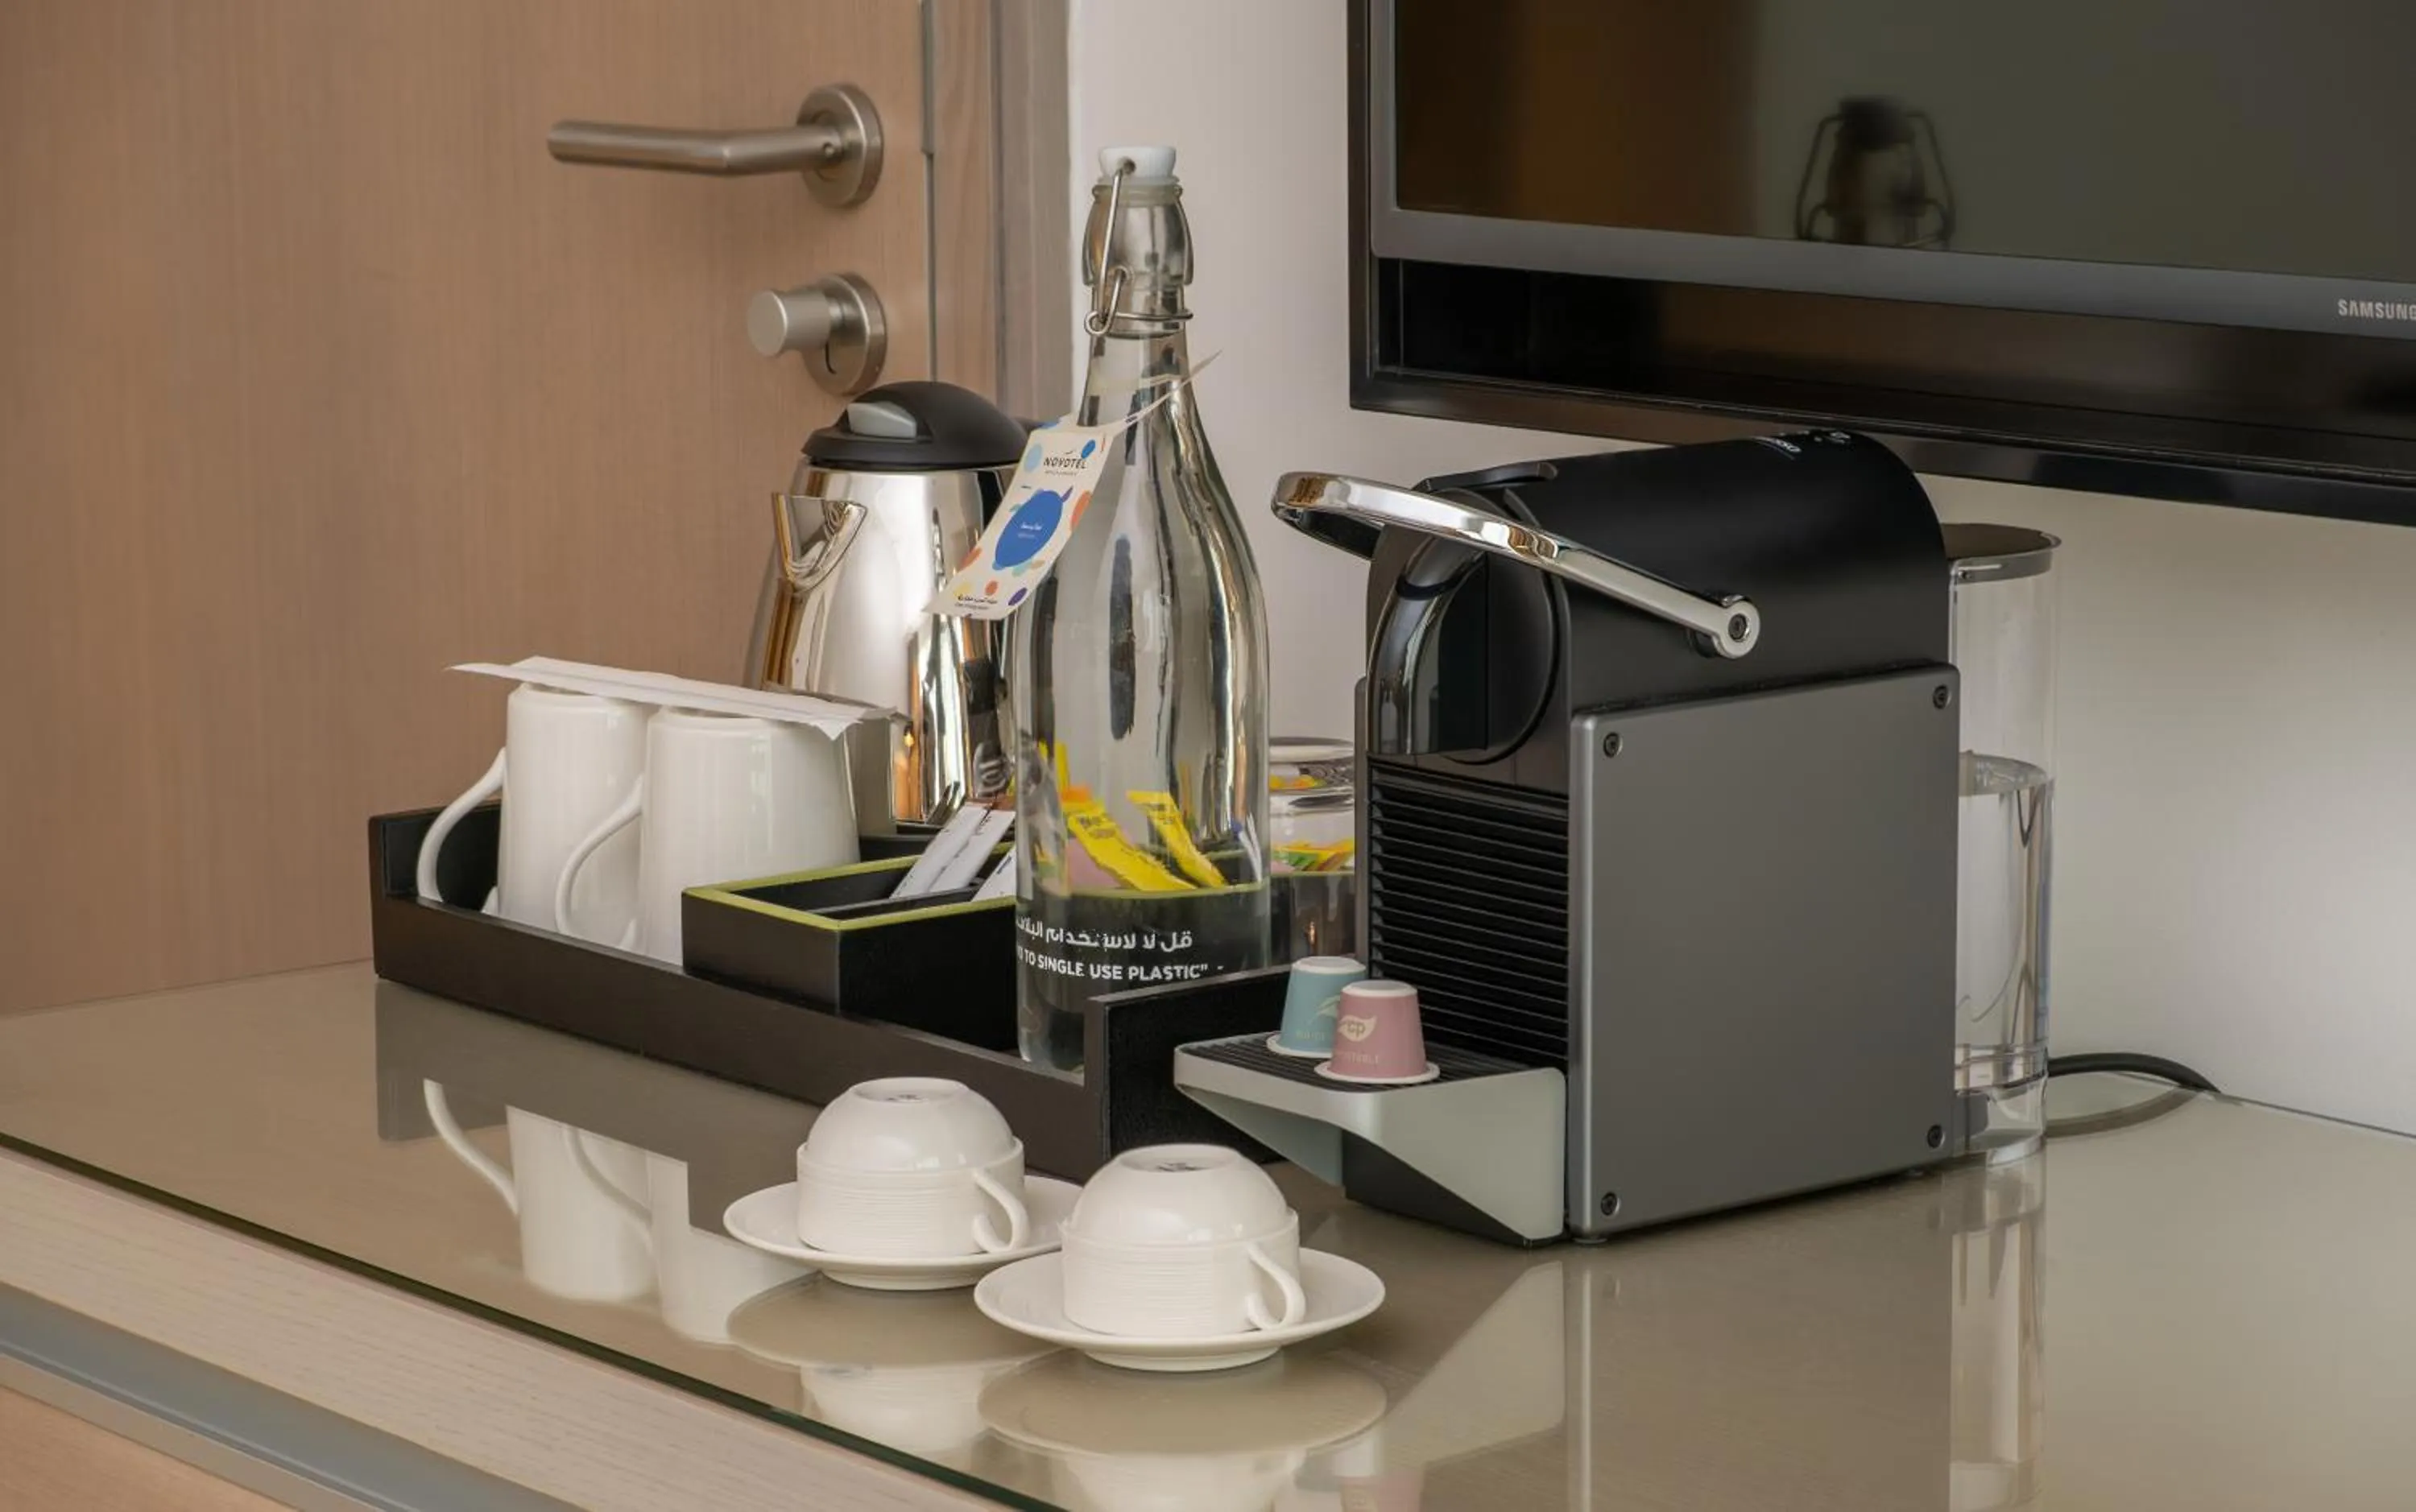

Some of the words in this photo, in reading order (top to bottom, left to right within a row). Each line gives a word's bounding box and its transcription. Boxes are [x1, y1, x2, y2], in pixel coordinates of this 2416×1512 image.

[2337, 299, 2416, 320] SAMSUNG
[1043, 456, 1087, 469] NOVOTEL
[1142, 931, 1156, 949] لا
[1160, 930, 1194, 953] قل
[1024, 948, 1036, 966] TO
[1037, 953, 1086, 977] SINGLE
[1089, 964, 1123, 980] USE
